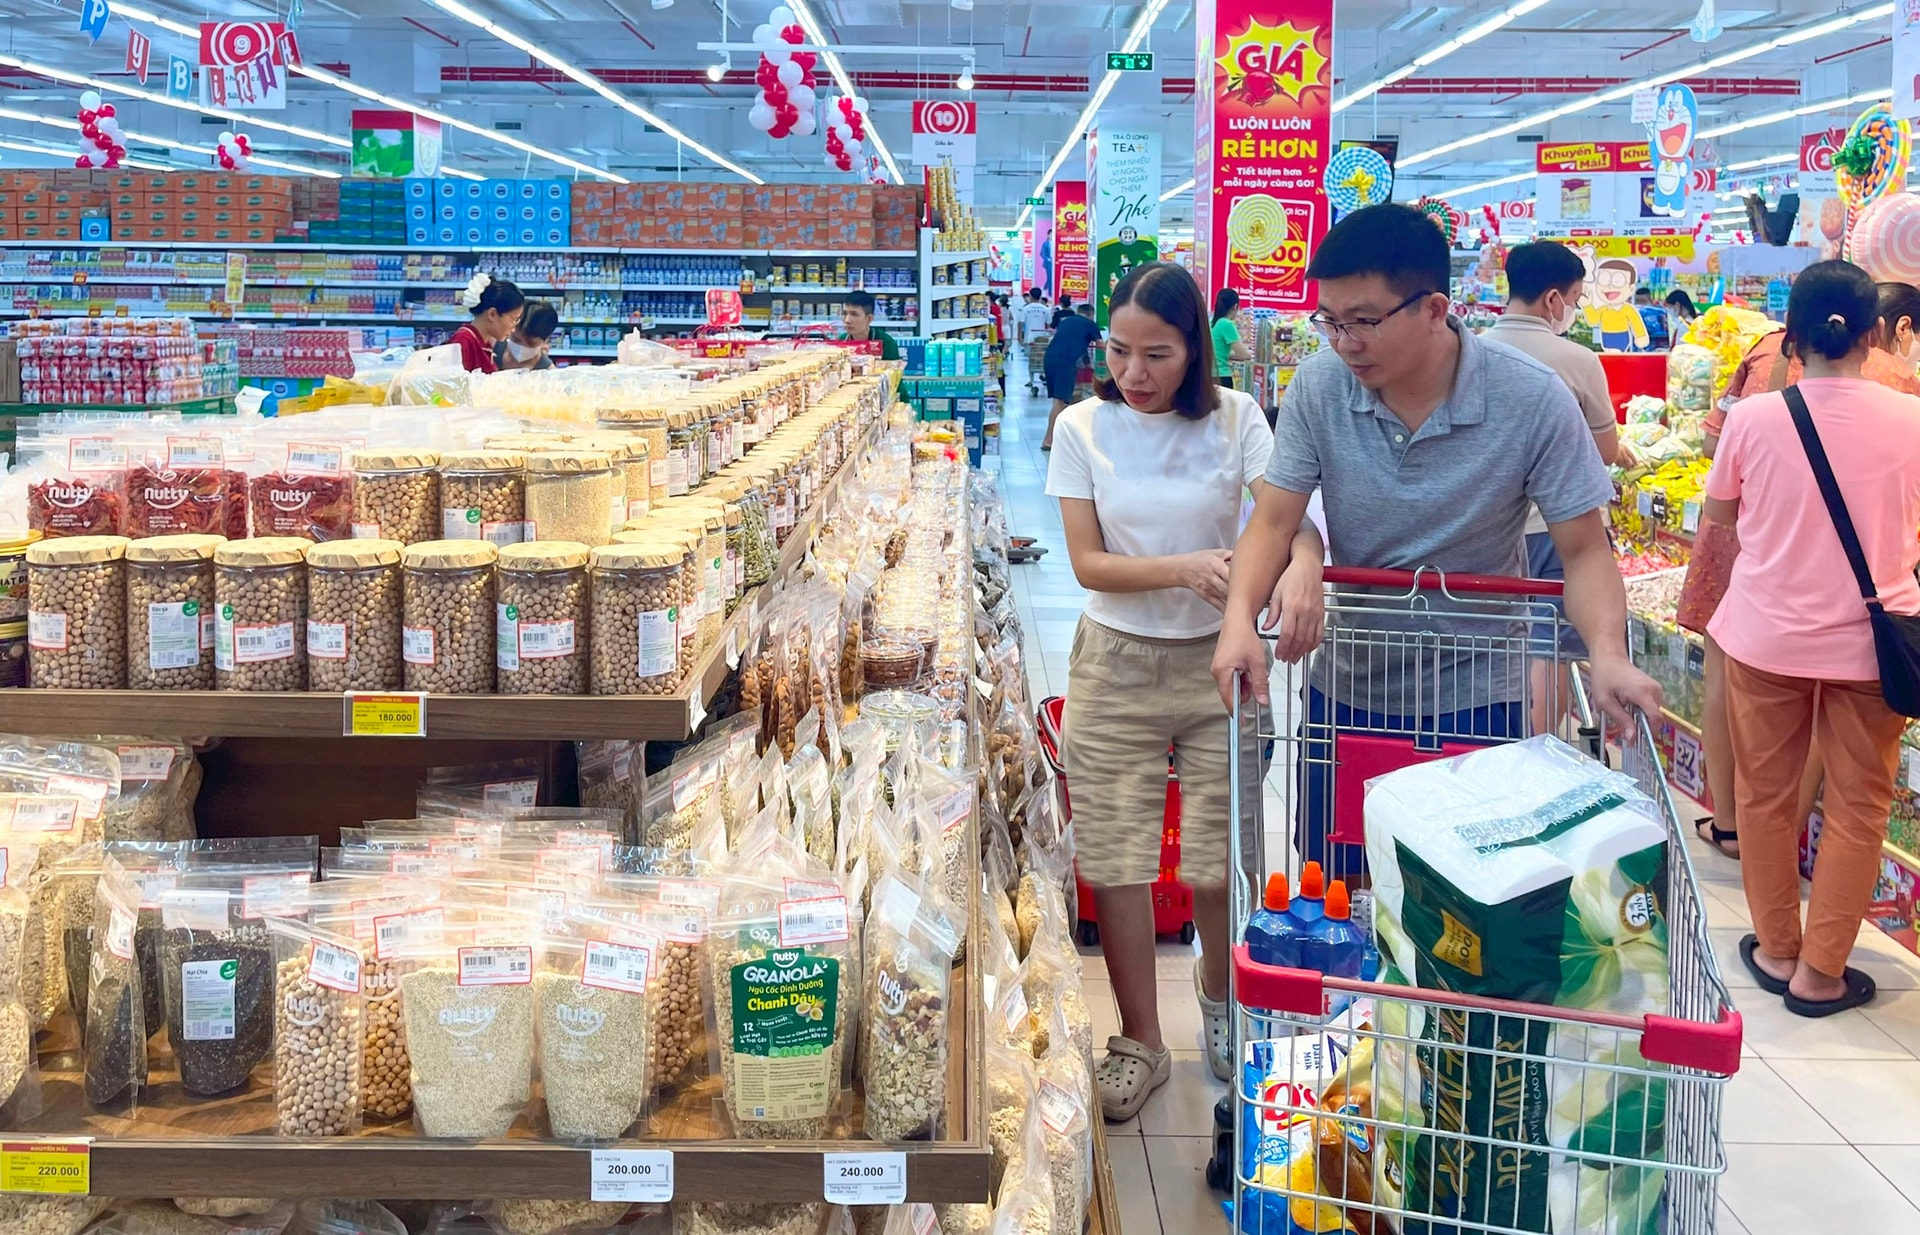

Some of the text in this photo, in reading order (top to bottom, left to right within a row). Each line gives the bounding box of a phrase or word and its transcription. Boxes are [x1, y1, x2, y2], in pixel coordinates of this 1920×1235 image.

[234, 36, 251, 55] 9
[1237, 40, 1309, 83] GIÁ
[935, 111, 955, 126] 10
[1229, 116, 1311, 131] LUÔN LUÔN
[1222, 132, 1317, 158] RẺ HƠN
[1543, 146, 1592, 161] Khuyến
[1579, 154, 1608, 169] Mãi!
[1236, 166, 1302, 178] Tiết kiệm hơn
[1224, 177, 1315, 189] mỗi ngày cùng GO!
[1109, 194, 1154, 226] Nhẹ
[1628, 239, 1681, 256] 16.900
[48, 486, 94, 503] nutty
[145, 487, 191, 503] nutty
[270, 488, 313, 504] nutty
[378, 713, 412, 722] 180.000
[1630, 911, 1646, 926] 3
[1457, 930, 1473, 969] 100%
[773, 952, 800, 964] nutty
[743, 962, 826, 985] GRANOLA
[748, 979, 824, 995] Ngũ Cốc Dinh Dưỡng
[878, 970, 908, 1006] nutty
[747, 993, 816, 1011] Chanh Dây
[743, 1022, 754, 1032] 12
[1303, 1051, 1313, 1070] Milk
[1531, 1077, 1543, 1100] CAO
[1494, 1038, 1533, 1189] PREMIER
[38, 1166, 80, 1176] 220.000
[607, 1164, 651, 1175] 200.000
[841, 1166, 884, 1177] 240.000
